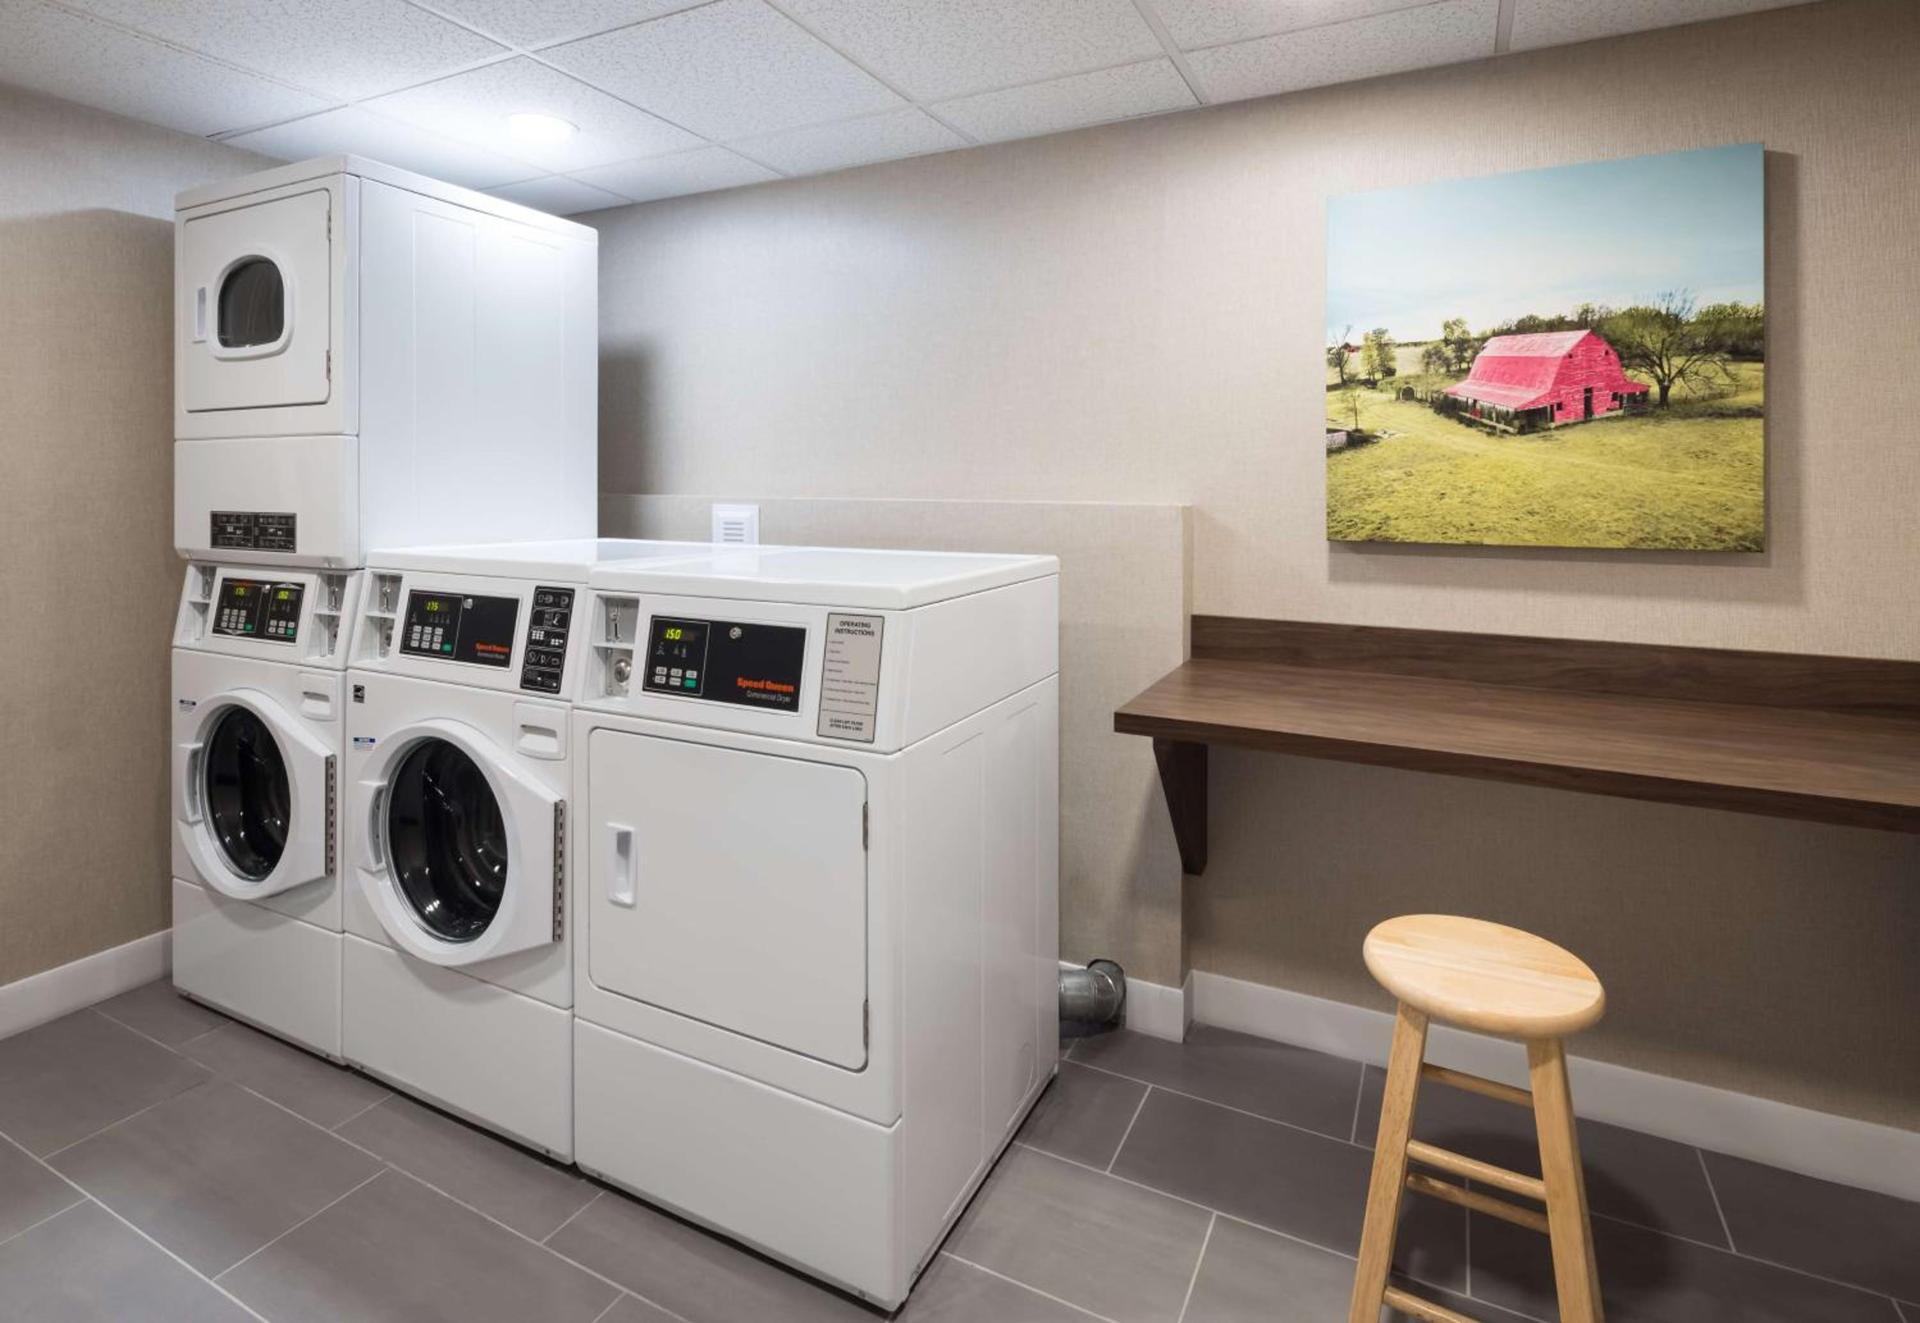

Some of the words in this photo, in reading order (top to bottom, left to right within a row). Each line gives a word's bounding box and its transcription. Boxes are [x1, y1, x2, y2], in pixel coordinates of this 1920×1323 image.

[839, 620, 872, 628] OPERATING
[665, 628, 682, 640] 150
[834, 628, 875, 637] INSTRUCTIONS
[736, 677, 765, 689] Speed
[766, 680, 795, 692] Queen
